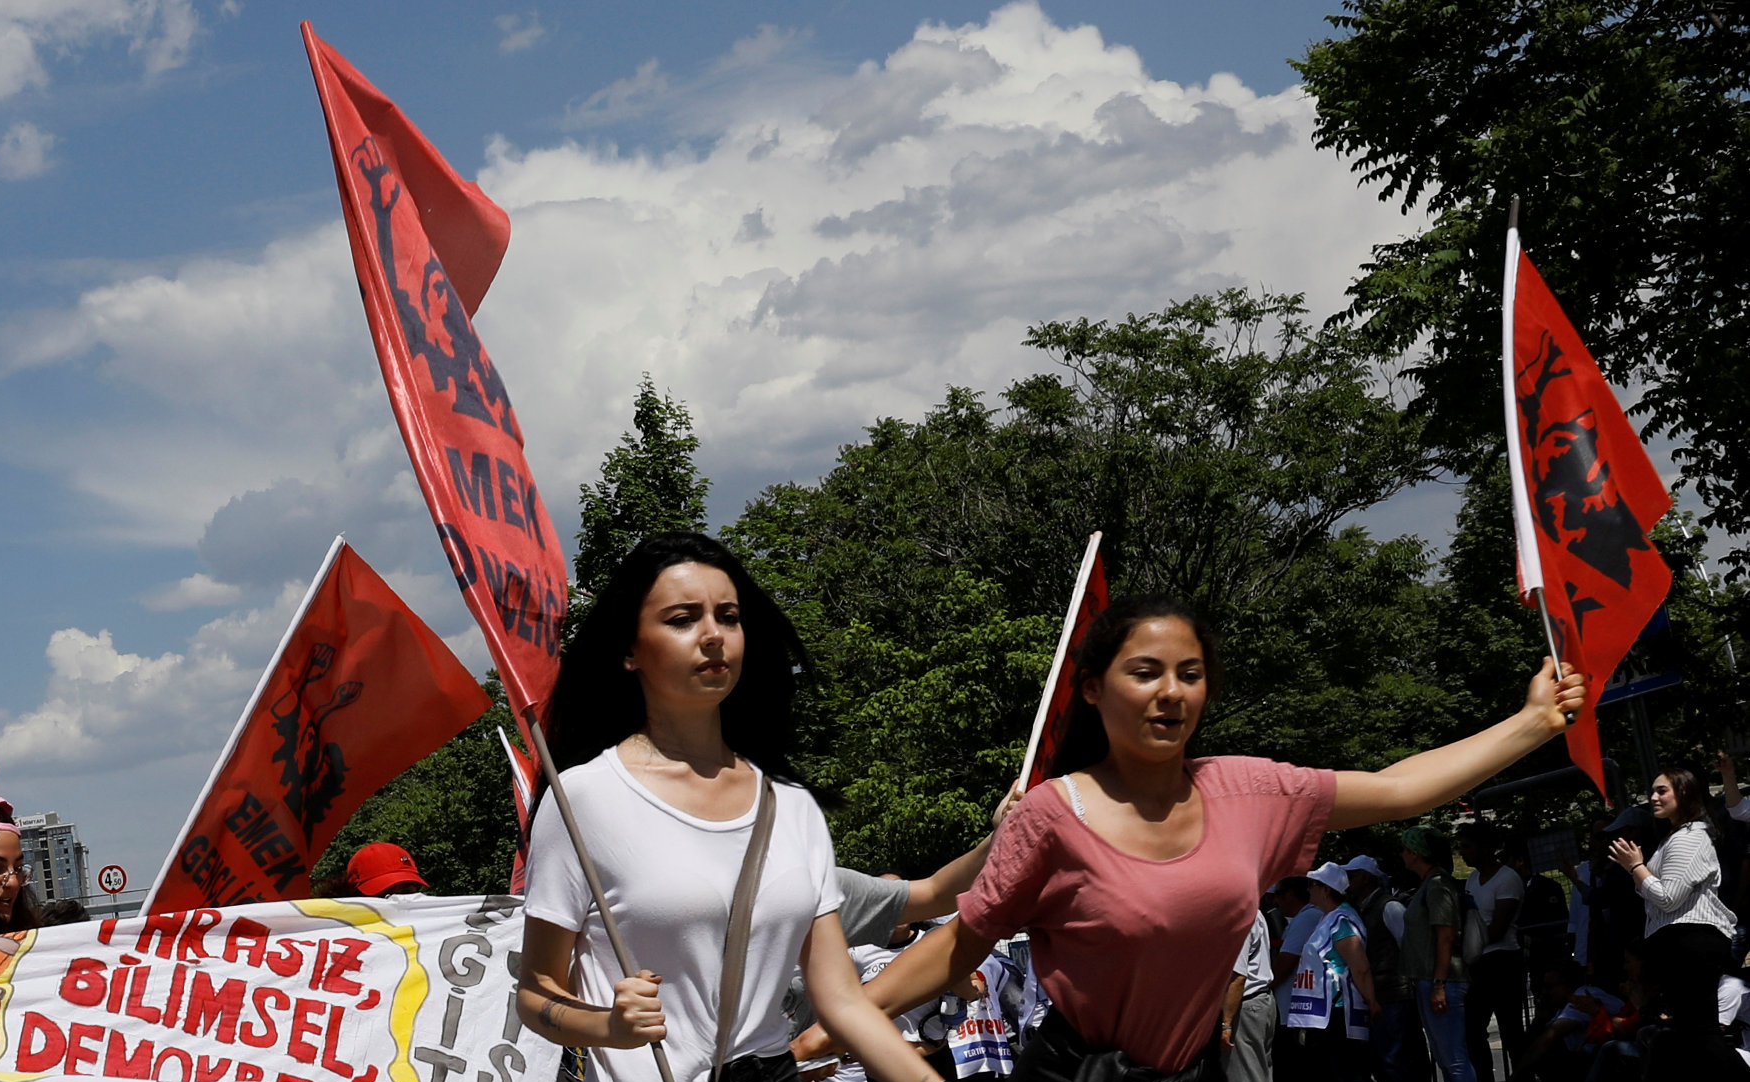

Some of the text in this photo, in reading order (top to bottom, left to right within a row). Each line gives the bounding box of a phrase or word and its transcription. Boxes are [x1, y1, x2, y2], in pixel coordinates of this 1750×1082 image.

[445, 446, 546, 551] MEK
[225, 791, 308, 895] EMEK
[98, 908, 382, 1011] ARASIZ,
[956, 1016, 1007, 1041] görev
